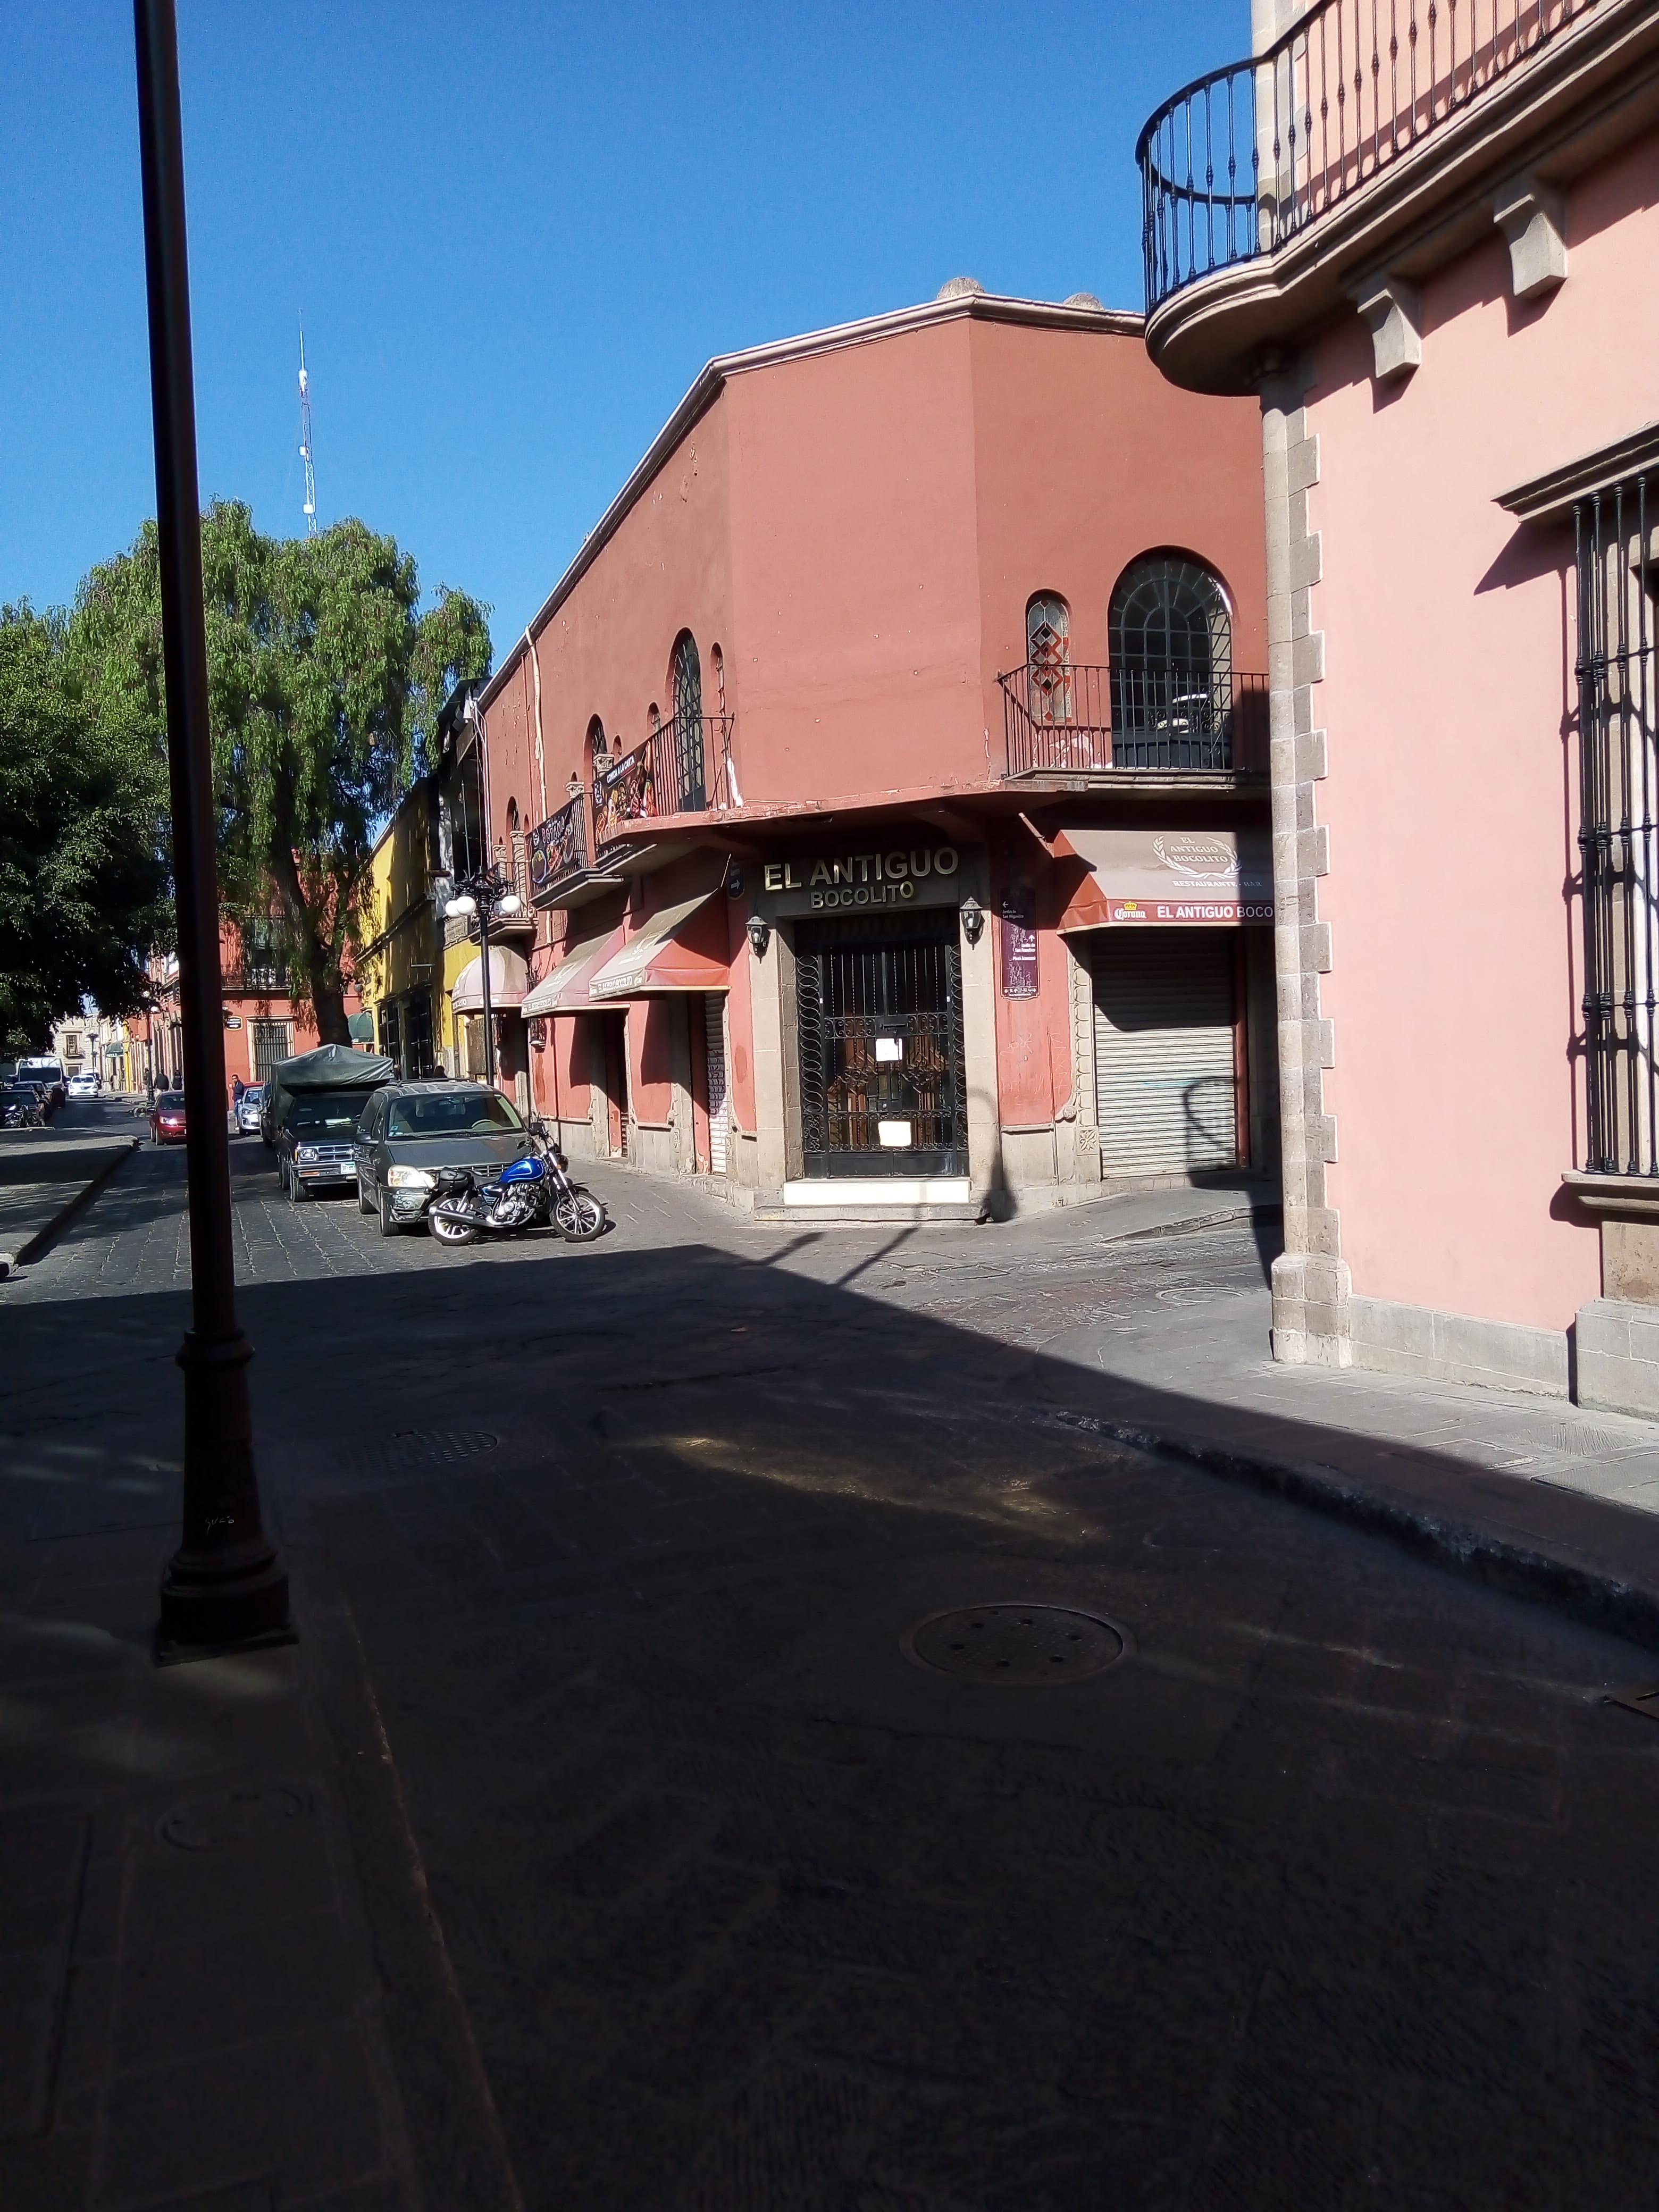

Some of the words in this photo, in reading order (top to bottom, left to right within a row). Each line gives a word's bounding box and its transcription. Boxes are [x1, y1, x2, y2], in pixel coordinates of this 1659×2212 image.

[764, 863, 802, 891] EL
[809, 847, 958, 886] ANTIGUO
[810, 881, 914, 909] BOCOLITO
[1115, 908, 1147, 920] Corona
[1157, 906, 1174, 918] EL
[1176, 906, 1234, 918] ANTIGUO
